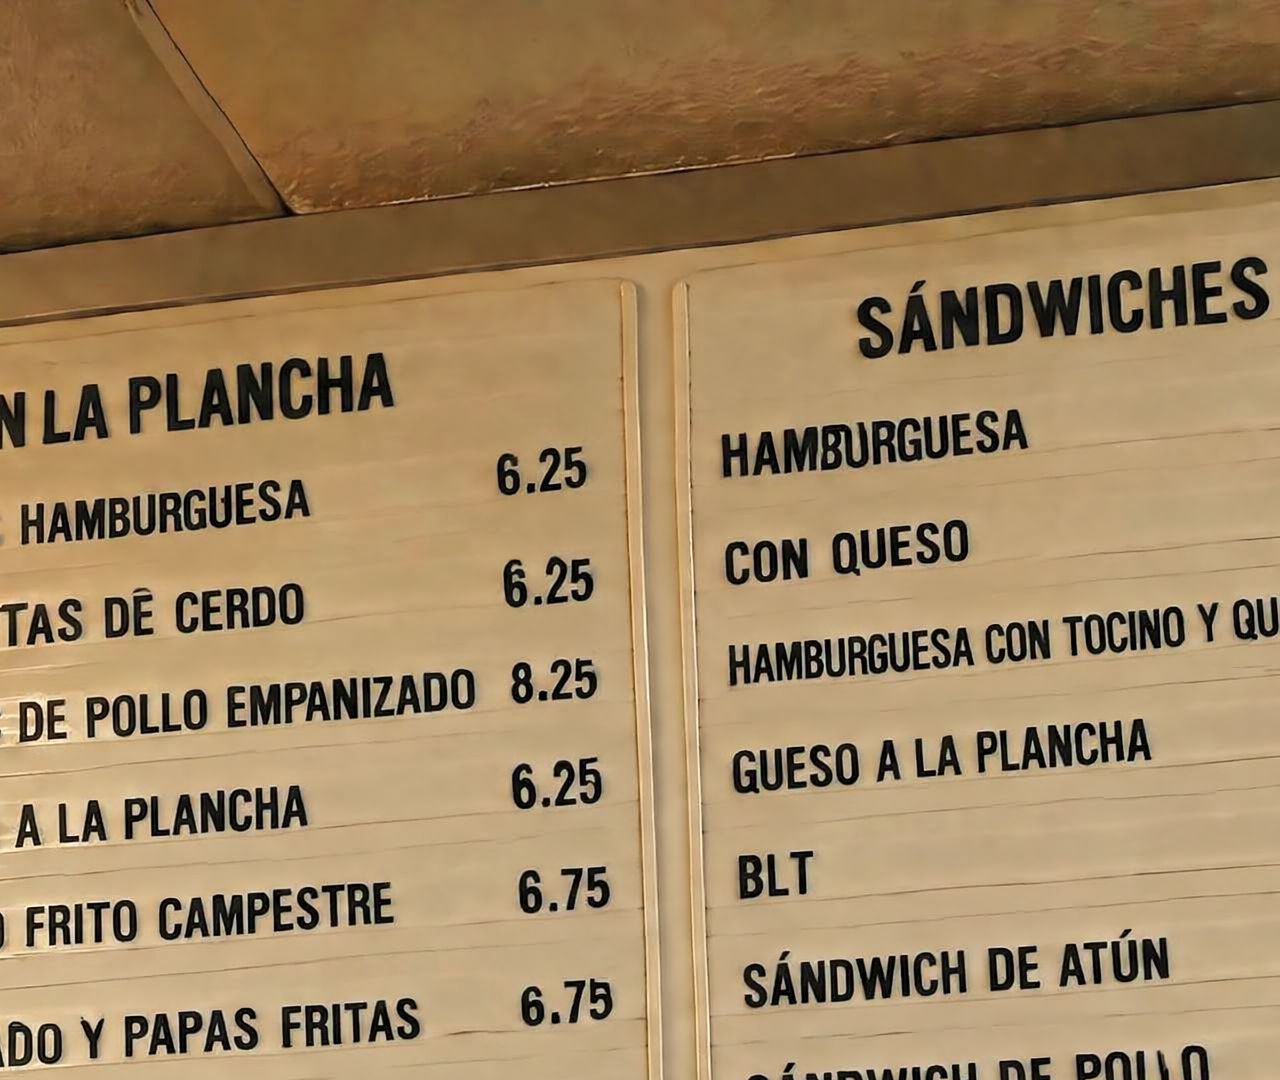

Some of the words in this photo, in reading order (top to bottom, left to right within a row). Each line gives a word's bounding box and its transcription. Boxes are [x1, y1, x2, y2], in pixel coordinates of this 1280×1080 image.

[856, 256, 1270, 360] SÁNDWICHES
[42, 383, 109, 445] LA
[128, 352, 395, 435] PLANCHA
[721, 409, 1029, 478] HAMBURGUESA
[21, 479, 311, 546] HAMBURGUESA
[496, 446, 588, 496] 6.25
[724, 537, 809, 586] CON
[831, 519, 969, 577] QUESO
[175, 582, 305, 634] CERDO
[502, 555, 594, 609] 6.25
[728, 627, 975, 687] HAMBURGUESA
[985, 619, 1051, 665] CON
[1062, 606, 1186, 657] TOCINO
[1196, 602, 1219, 643] Y
[19, 699, 67, 743] DE
[86, 688, 208, 739] POLLO
[226, 668, 476, 728] EMPANIZADO
[511, 657, 598, 705] 8.25
[876, 739, 901, 783] A
[914, 734, 963, 778] LA
[976, 718, 1152, 774] PLANCHA
[15, 804, 42, 848] A
[58, 799, 108, 844] LA
[124, 785, 309, 840] PLANCHA
[511, 756, 603, 810] 6.25
[25, 899, 138, 948] FRITO
[158, 881, 395, 941] CAMPESTRE
[518, 866, 611, 914] 6.75
[738, 850, 814, 900] BLT
[743, 950, 968, 1009] SÁNDWICH
[987, 945, 1041, 992] DE
[1059, 928, 1170, 988] ATÚN
[80, 1018, 105, 1059] Y
[124, 1007, 259, 1058] PAPAS
[281, 997, 421, 1049] FRITAS
[520, 978, 614, 1027] 6.75
